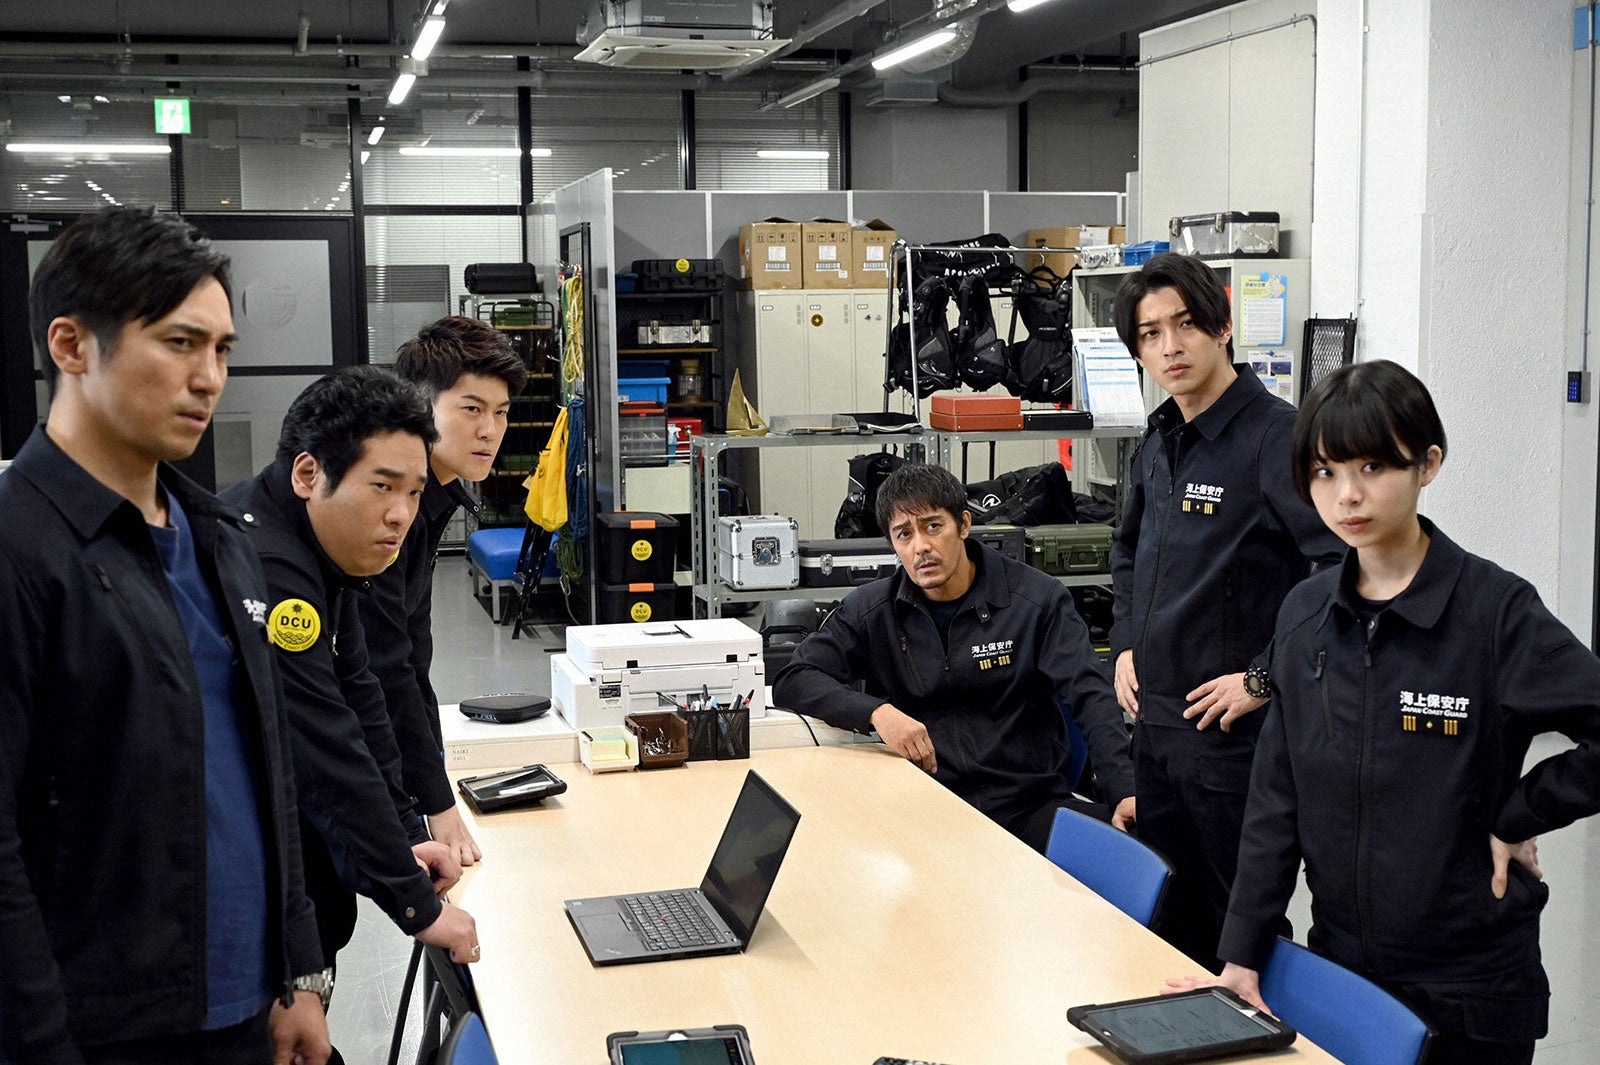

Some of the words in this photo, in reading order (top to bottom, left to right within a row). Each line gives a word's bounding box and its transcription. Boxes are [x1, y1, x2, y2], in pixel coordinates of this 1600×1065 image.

[1186, 483, 1224, 497] 海上保安庁
[281, 616, 311, 629] DCU
[972, 640, 1013, 654] 海上保安庁
[1400, 691, 1470, 711] 海上保安庁
[1401, 705, 1421, 713] JAPAN
[1444, 710, 1468, 718] GUARD
